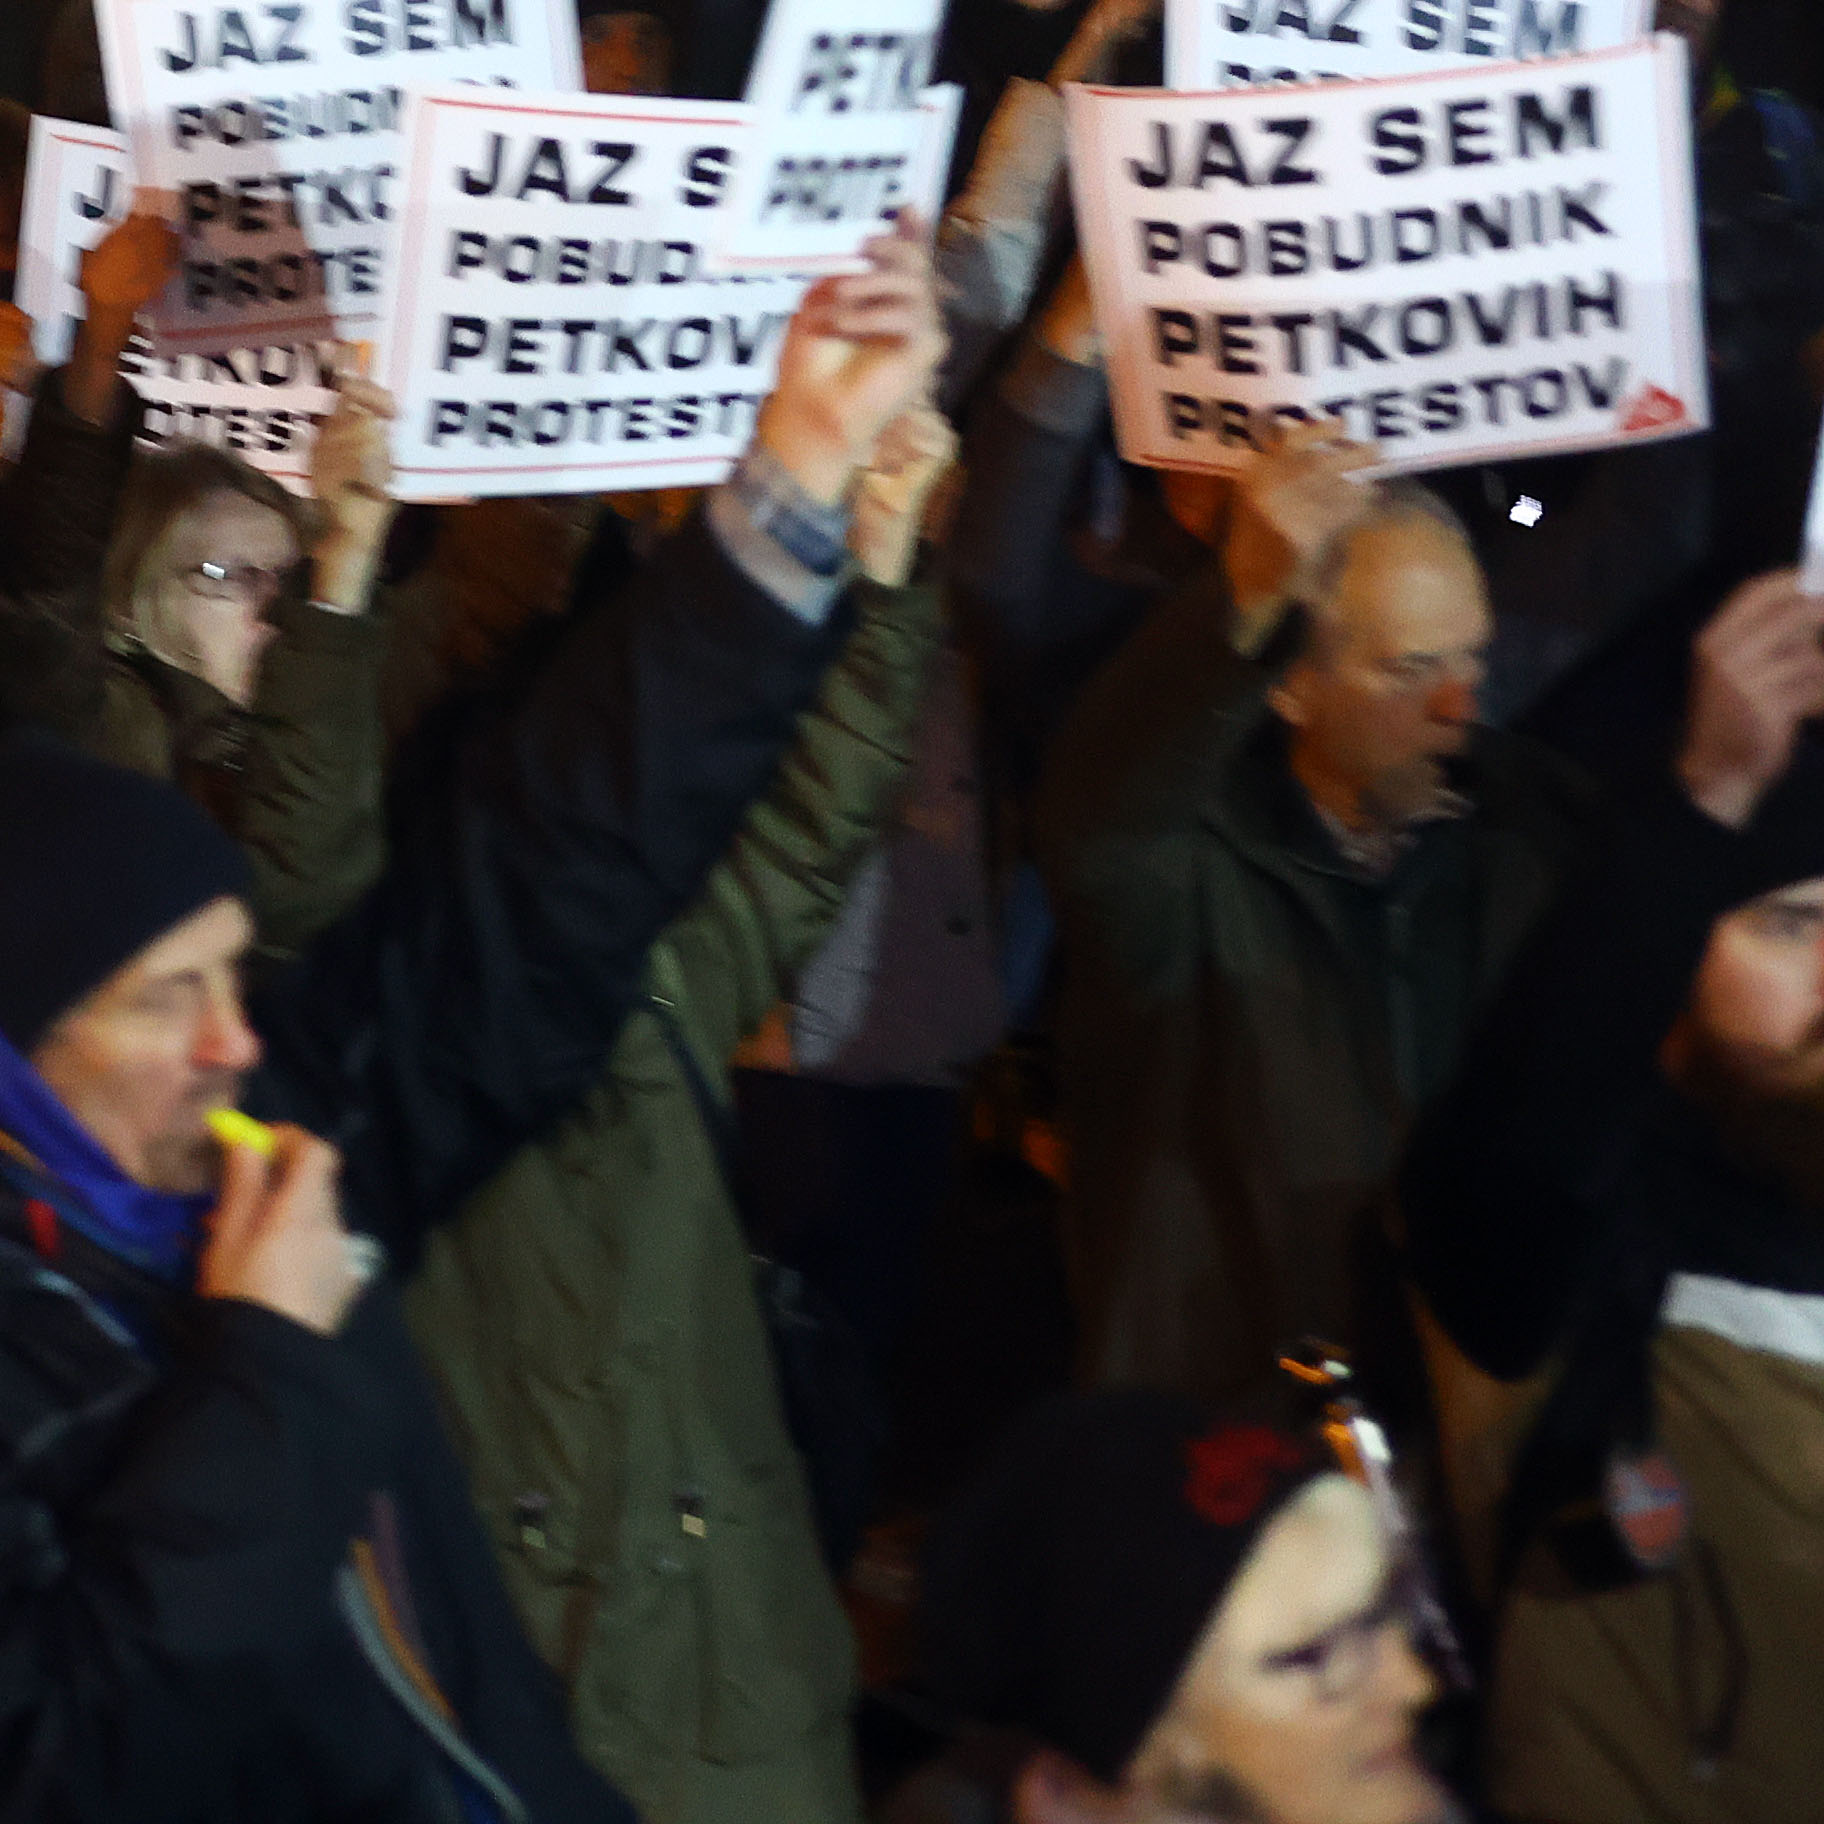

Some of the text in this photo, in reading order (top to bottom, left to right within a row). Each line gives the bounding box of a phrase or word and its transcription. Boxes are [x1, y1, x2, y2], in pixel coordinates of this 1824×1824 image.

[156, 1, 312, 74] JAZ
[453, 129, 645, 209] JAZ
[1124, 83, 1605, 191] JAZ SEM
[444, 228, 699, 288] POBUD
[1134, 179, 1616, 279] POBUDNIK
[182, 245, 382, 311] PROTE
[437, 308, 776, 379] PETKOV
[1144, 266, 1627, 378] PETKOVIH
[426, 388, 754, 452] PROTEST
[1159, 356, 1629, 456] PRESTOV
